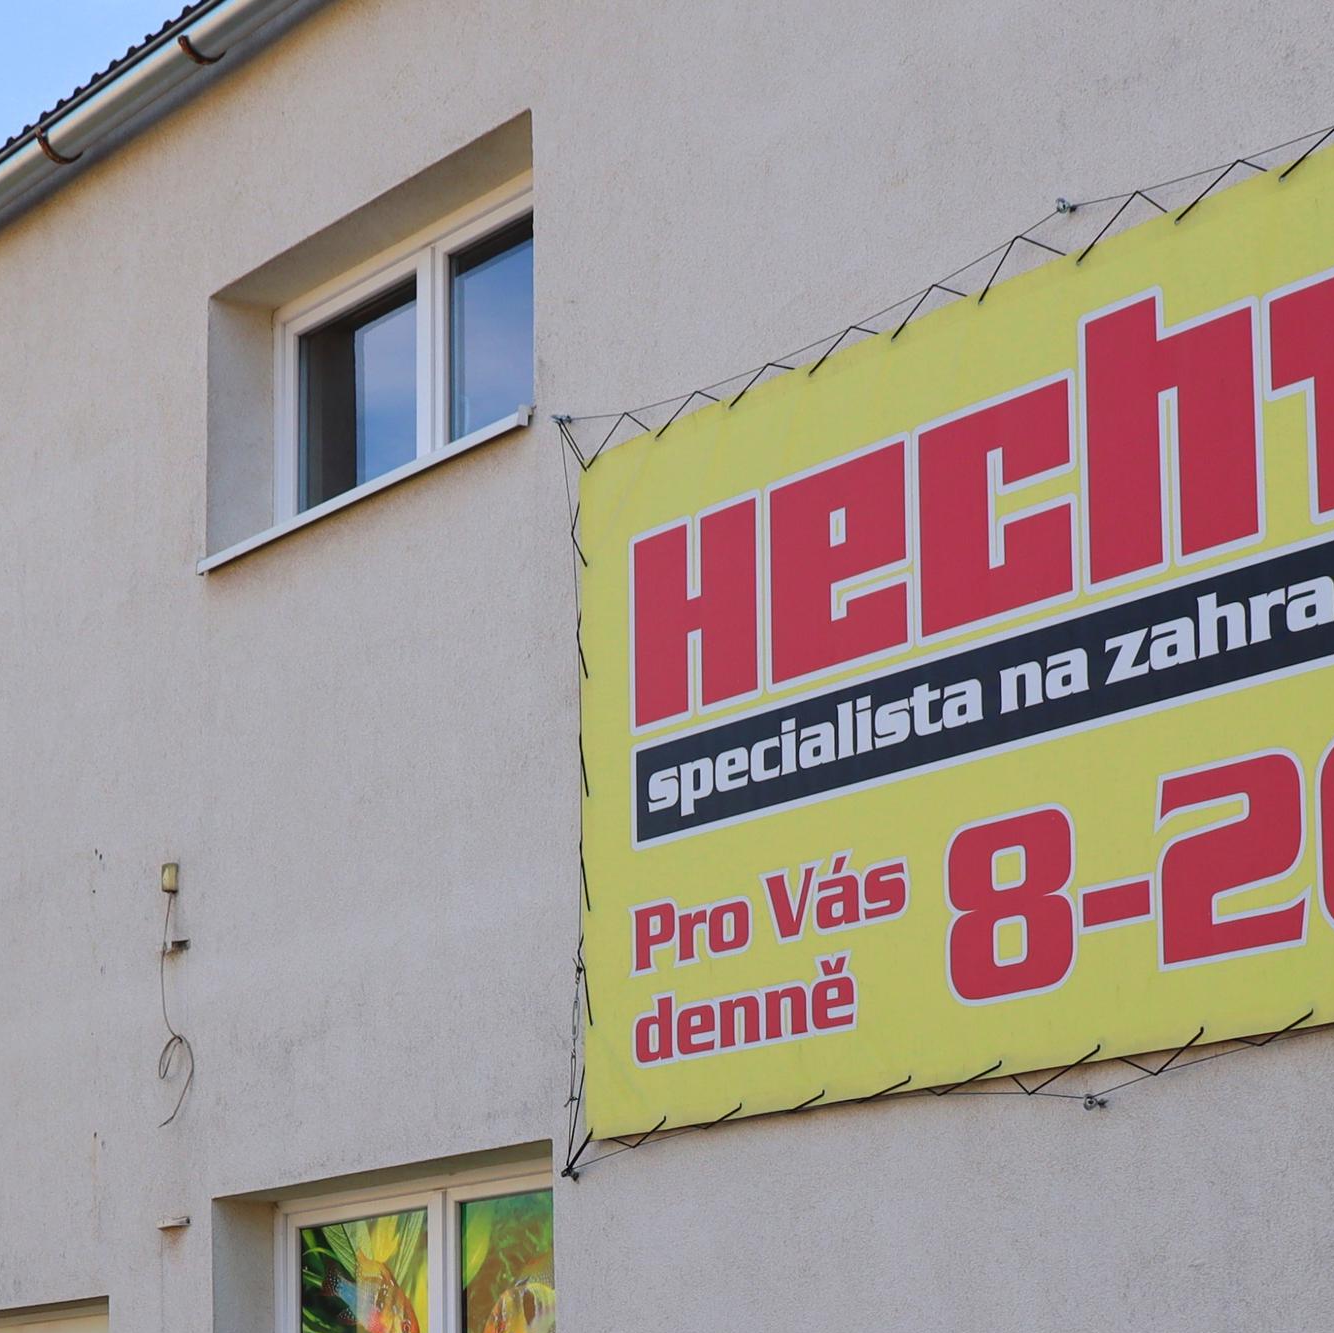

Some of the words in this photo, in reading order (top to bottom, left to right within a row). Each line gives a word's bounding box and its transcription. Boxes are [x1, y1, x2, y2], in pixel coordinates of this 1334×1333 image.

[645, 679, 984, 817] specialista
[998, 649, 1090, 710] na
[633, 896, 750, 974] Pro
[765, 853, 910, 940] Vás
[633, 954, 857, 1064] denně
